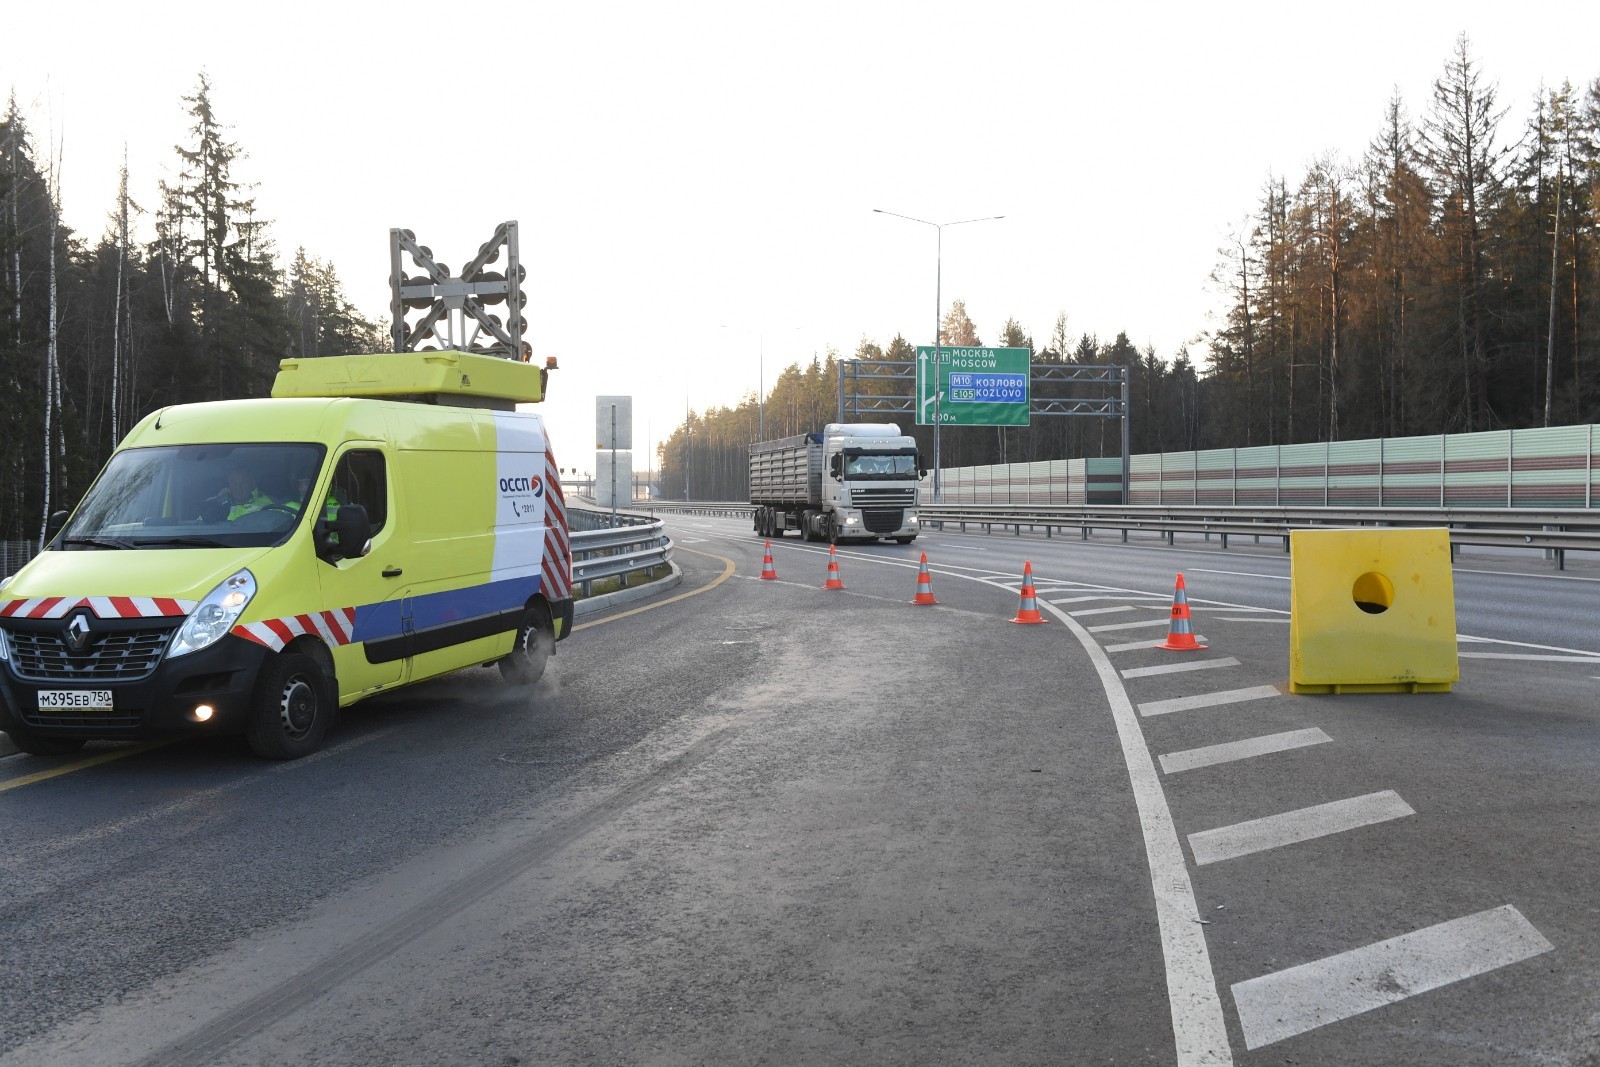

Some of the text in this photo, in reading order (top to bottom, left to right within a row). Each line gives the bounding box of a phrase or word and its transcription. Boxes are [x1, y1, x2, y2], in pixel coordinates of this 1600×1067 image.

[952, 349, 995, 358] МОСКВА
[952, 359, 997, 368] MOSCOW
[976, 379, 1023, 387] КОЗЛОВО
[953, 389, 974, 398] E105
[976, 389, 1021, 398] KOZLOVO
[499, 477, 530, 492] ОССП
[91, 691, 109, 702] 750
